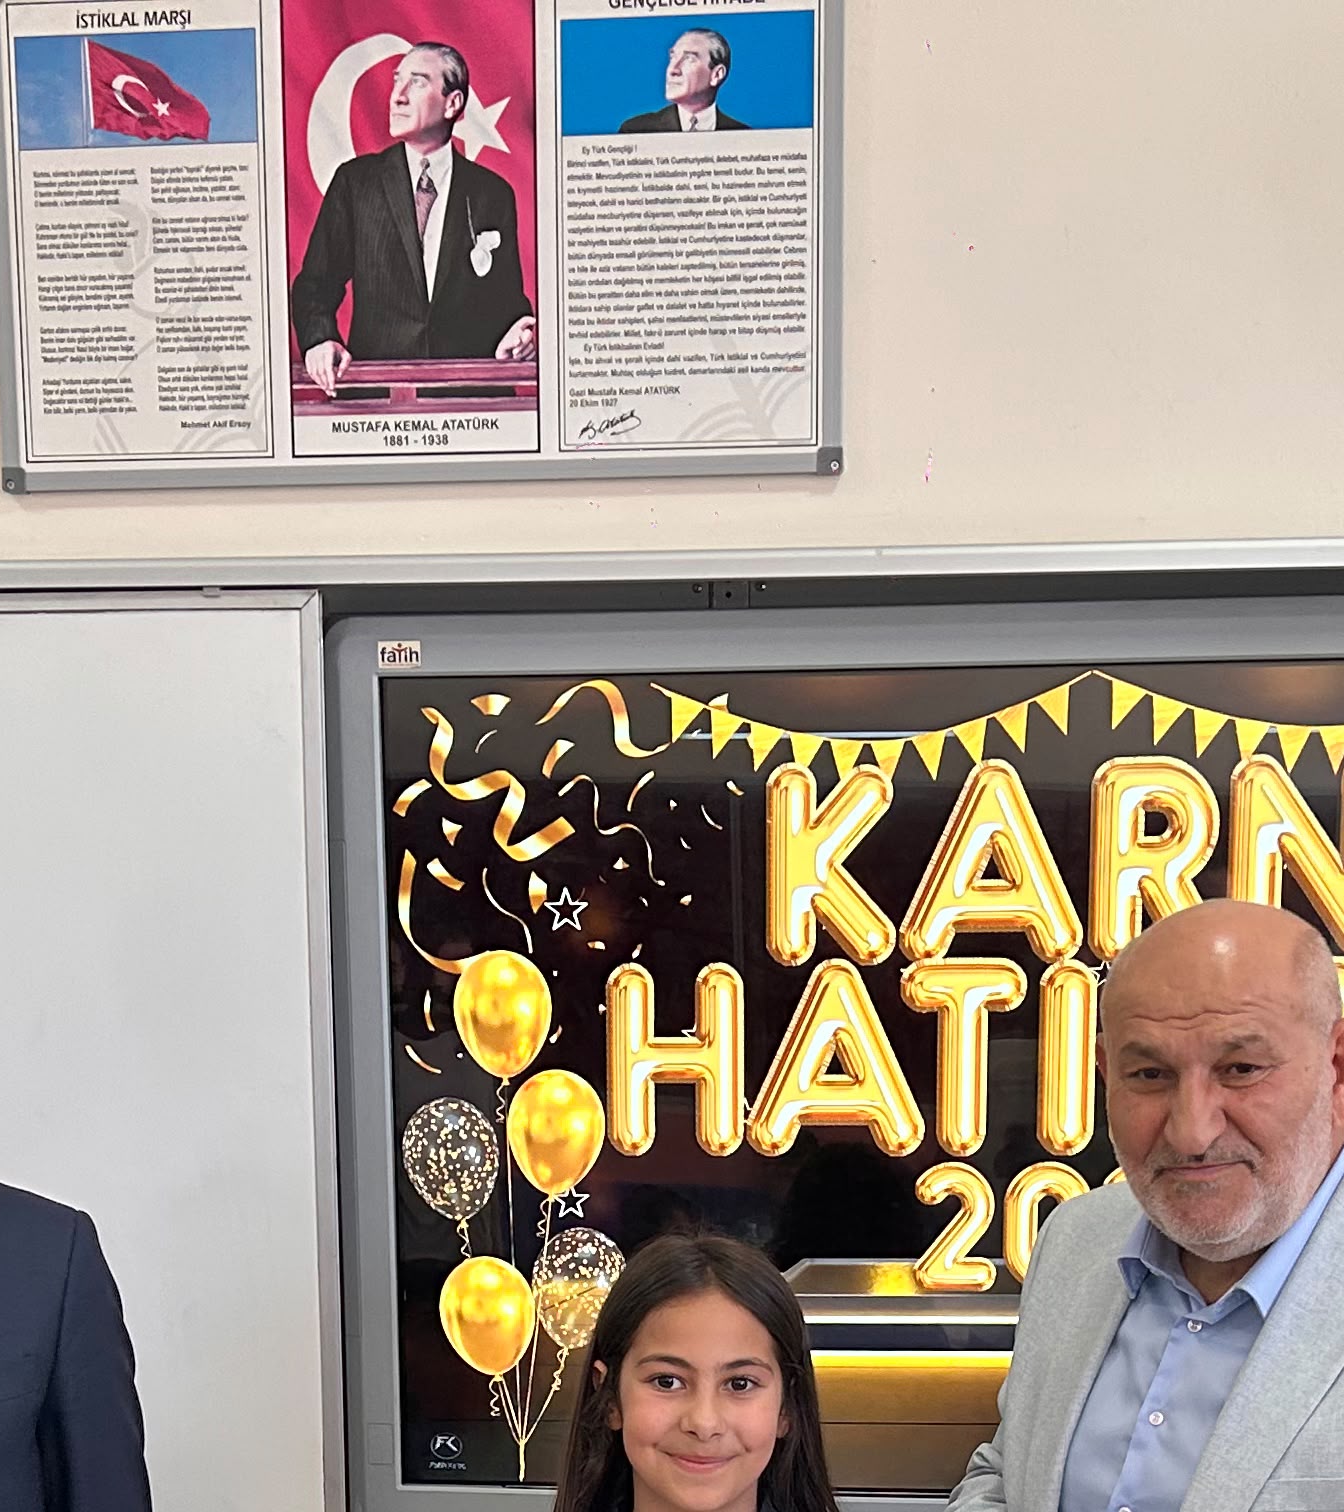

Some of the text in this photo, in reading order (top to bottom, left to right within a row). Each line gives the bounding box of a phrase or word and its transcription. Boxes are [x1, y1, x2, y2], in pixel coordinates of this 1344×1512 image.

[76, 9, 191, 29] İSTİKLAL MARŞI
[644, 385, 680, 395] ATATÜRK
[570, 399, 578, 408] 20
[332, 418, 499, 433] MUSTAFA KEMAL ATATÜRK
[383, 435, 409, 447] 1881
[422, 434, 448, 446] 1938
